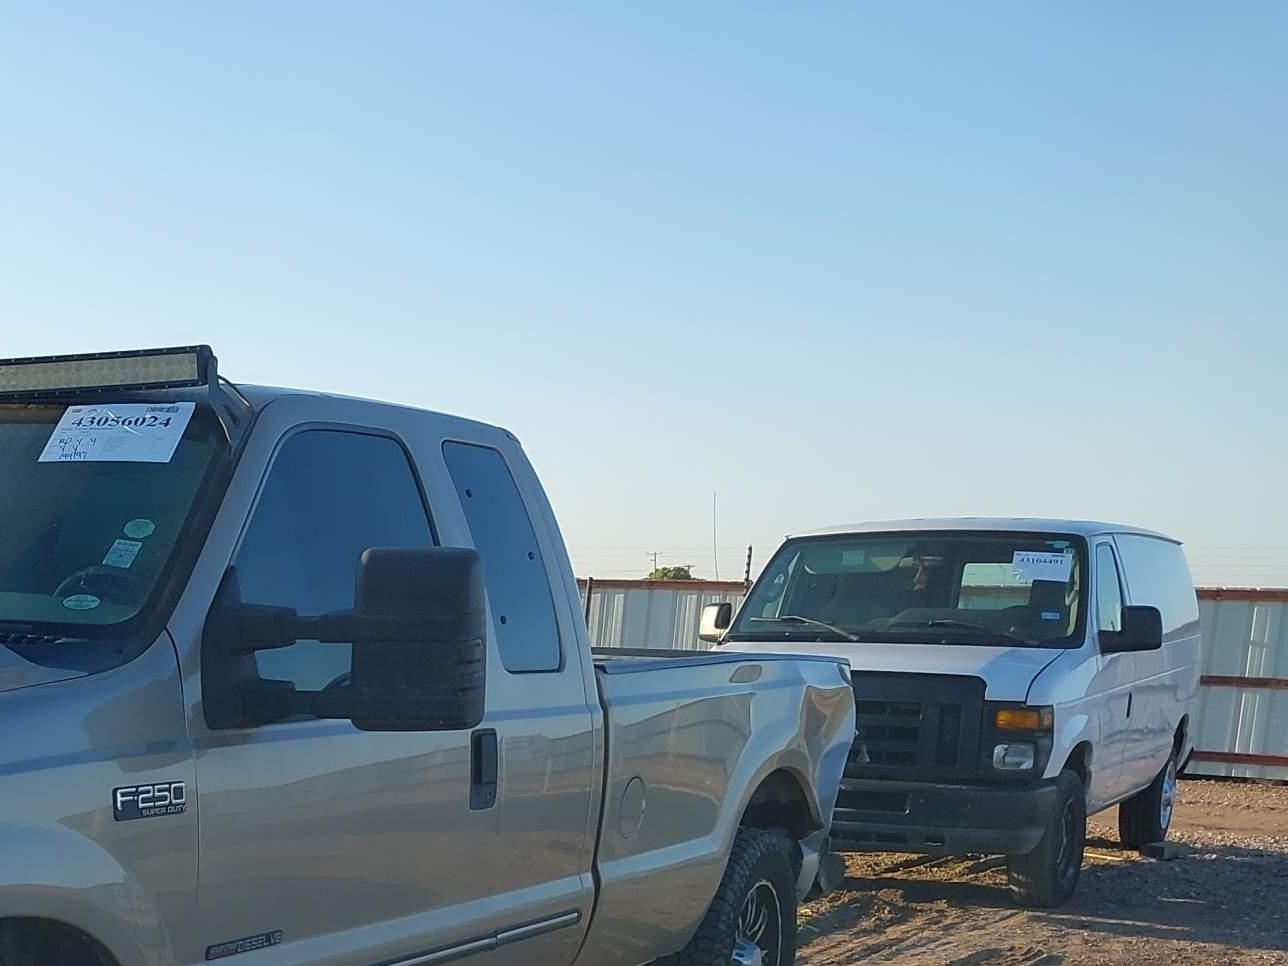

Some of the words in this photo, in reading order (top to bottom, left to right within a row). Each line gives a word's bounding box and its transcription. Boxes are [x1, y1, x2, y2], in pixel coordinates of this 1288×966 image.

[71, 415, 172, 428] 43056024
[142, 807, 166, 816] SUPER
[167, 805, 187, 813] DUTY
